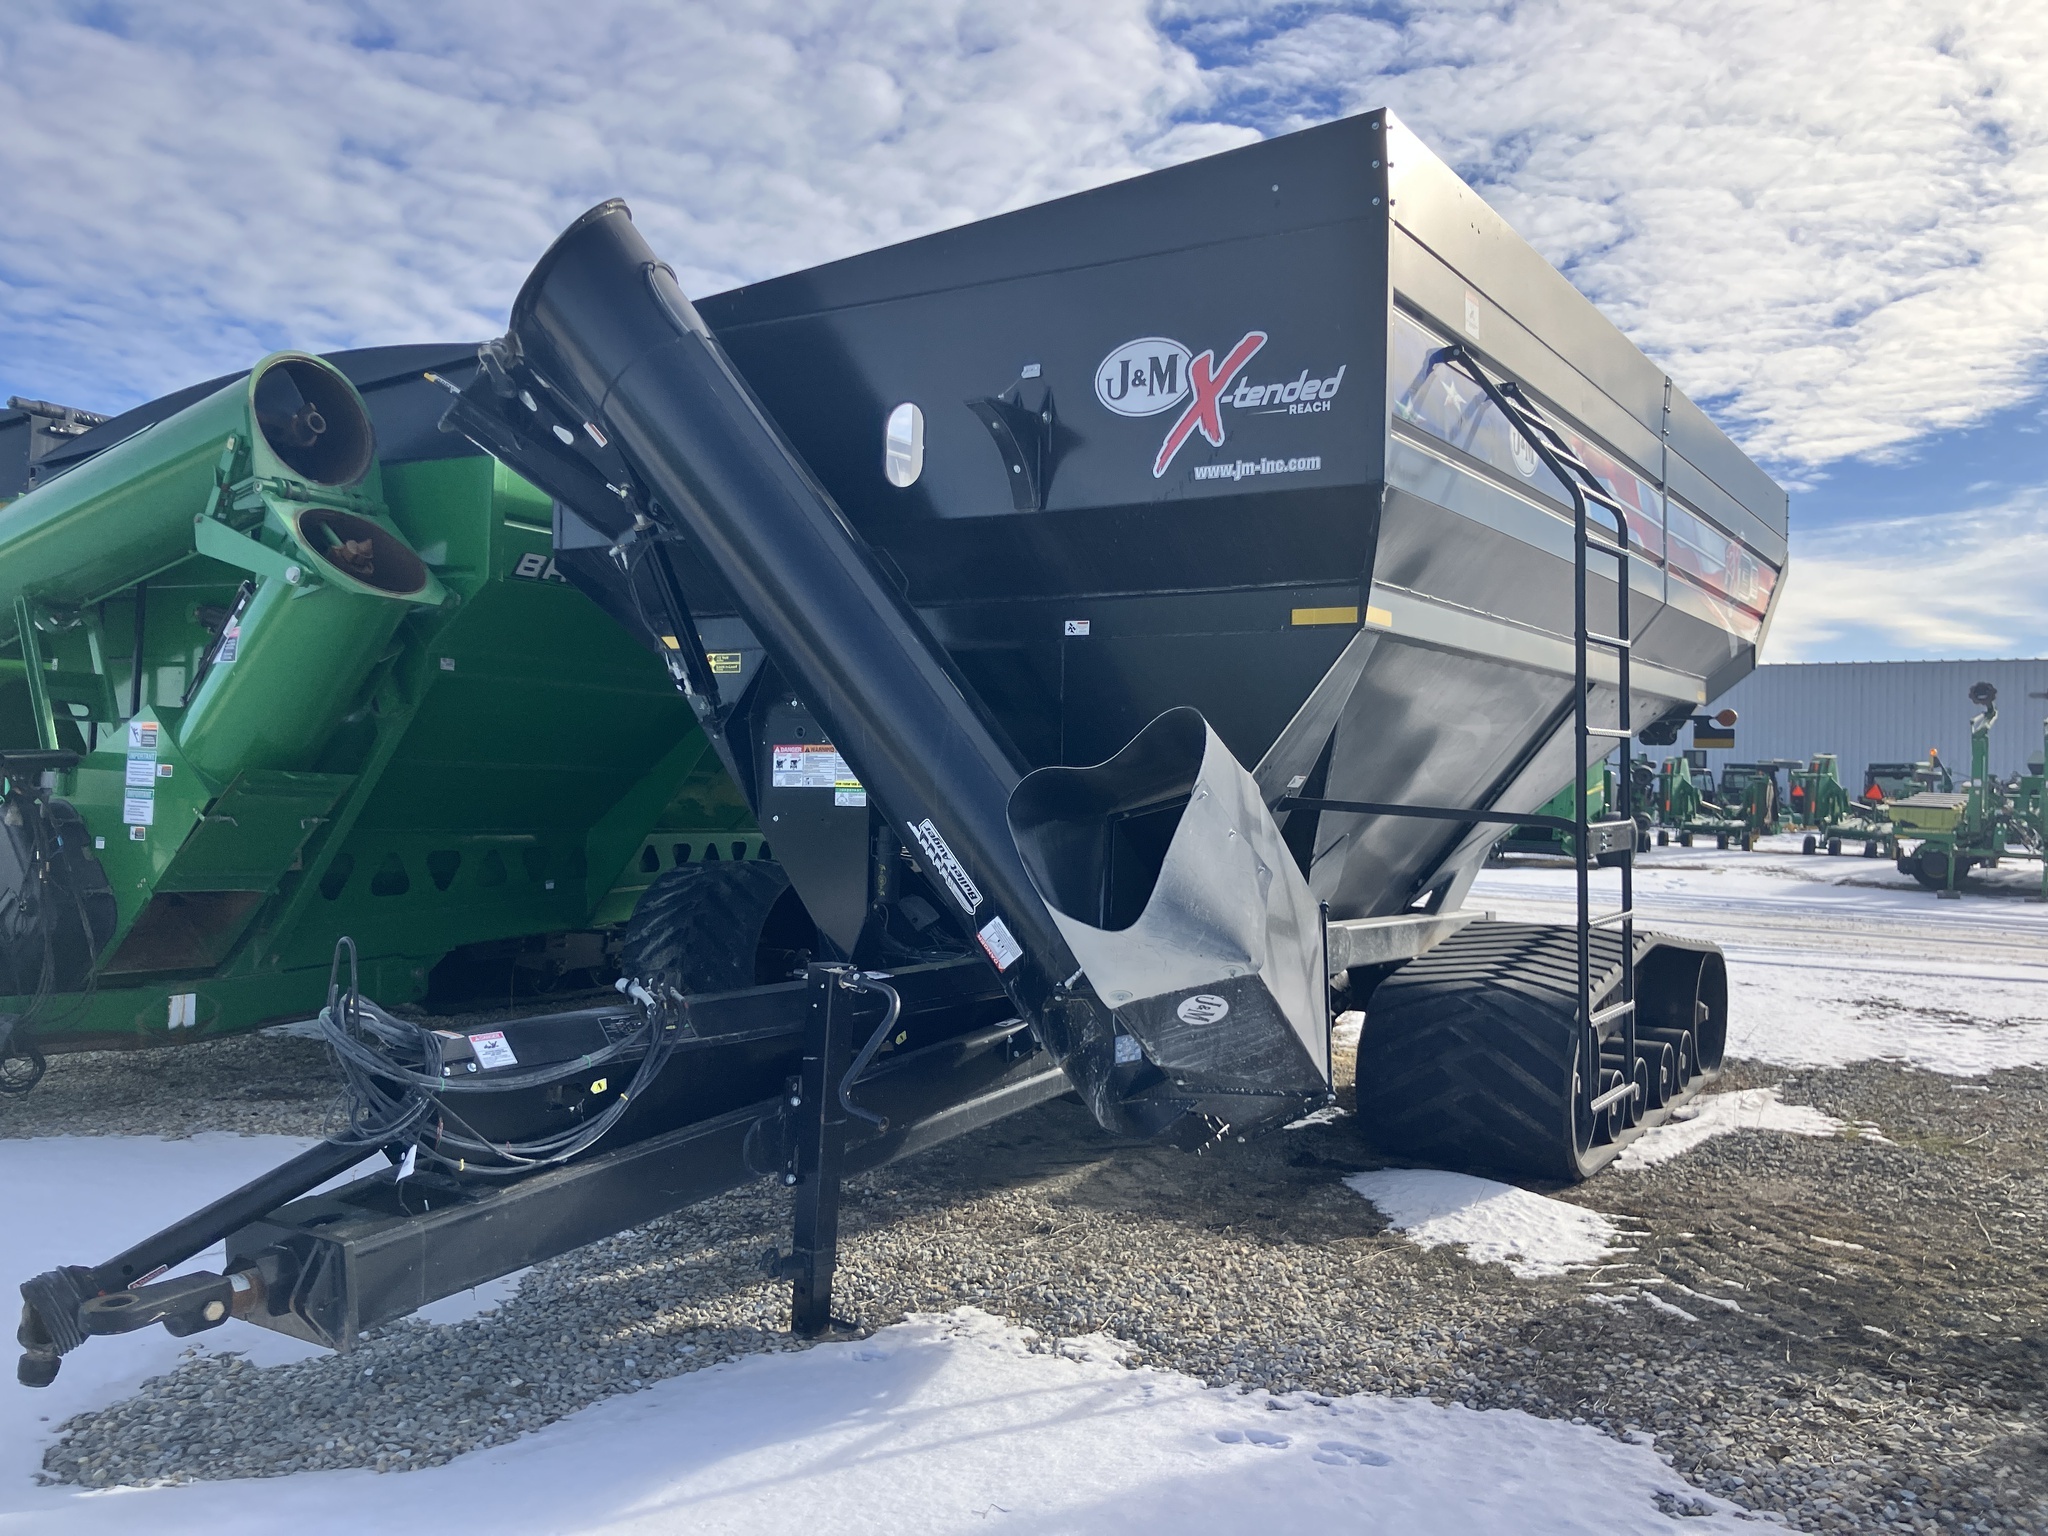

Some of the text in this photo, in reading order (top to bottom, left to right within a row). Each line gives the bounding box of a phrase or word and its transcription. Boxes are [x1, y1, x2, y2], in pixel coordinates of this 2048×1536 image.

[1106, 354, 1179, 400] J&M
[1289, 401, 1331, 415] REACH
[1194, 456, 1321, 481] www.jm-inc.com
[923, 826, 978, 900] Bullet Auger
[977, 933, 999, 965] DANGER
[1182, 996, 1222, 1023] J&M
